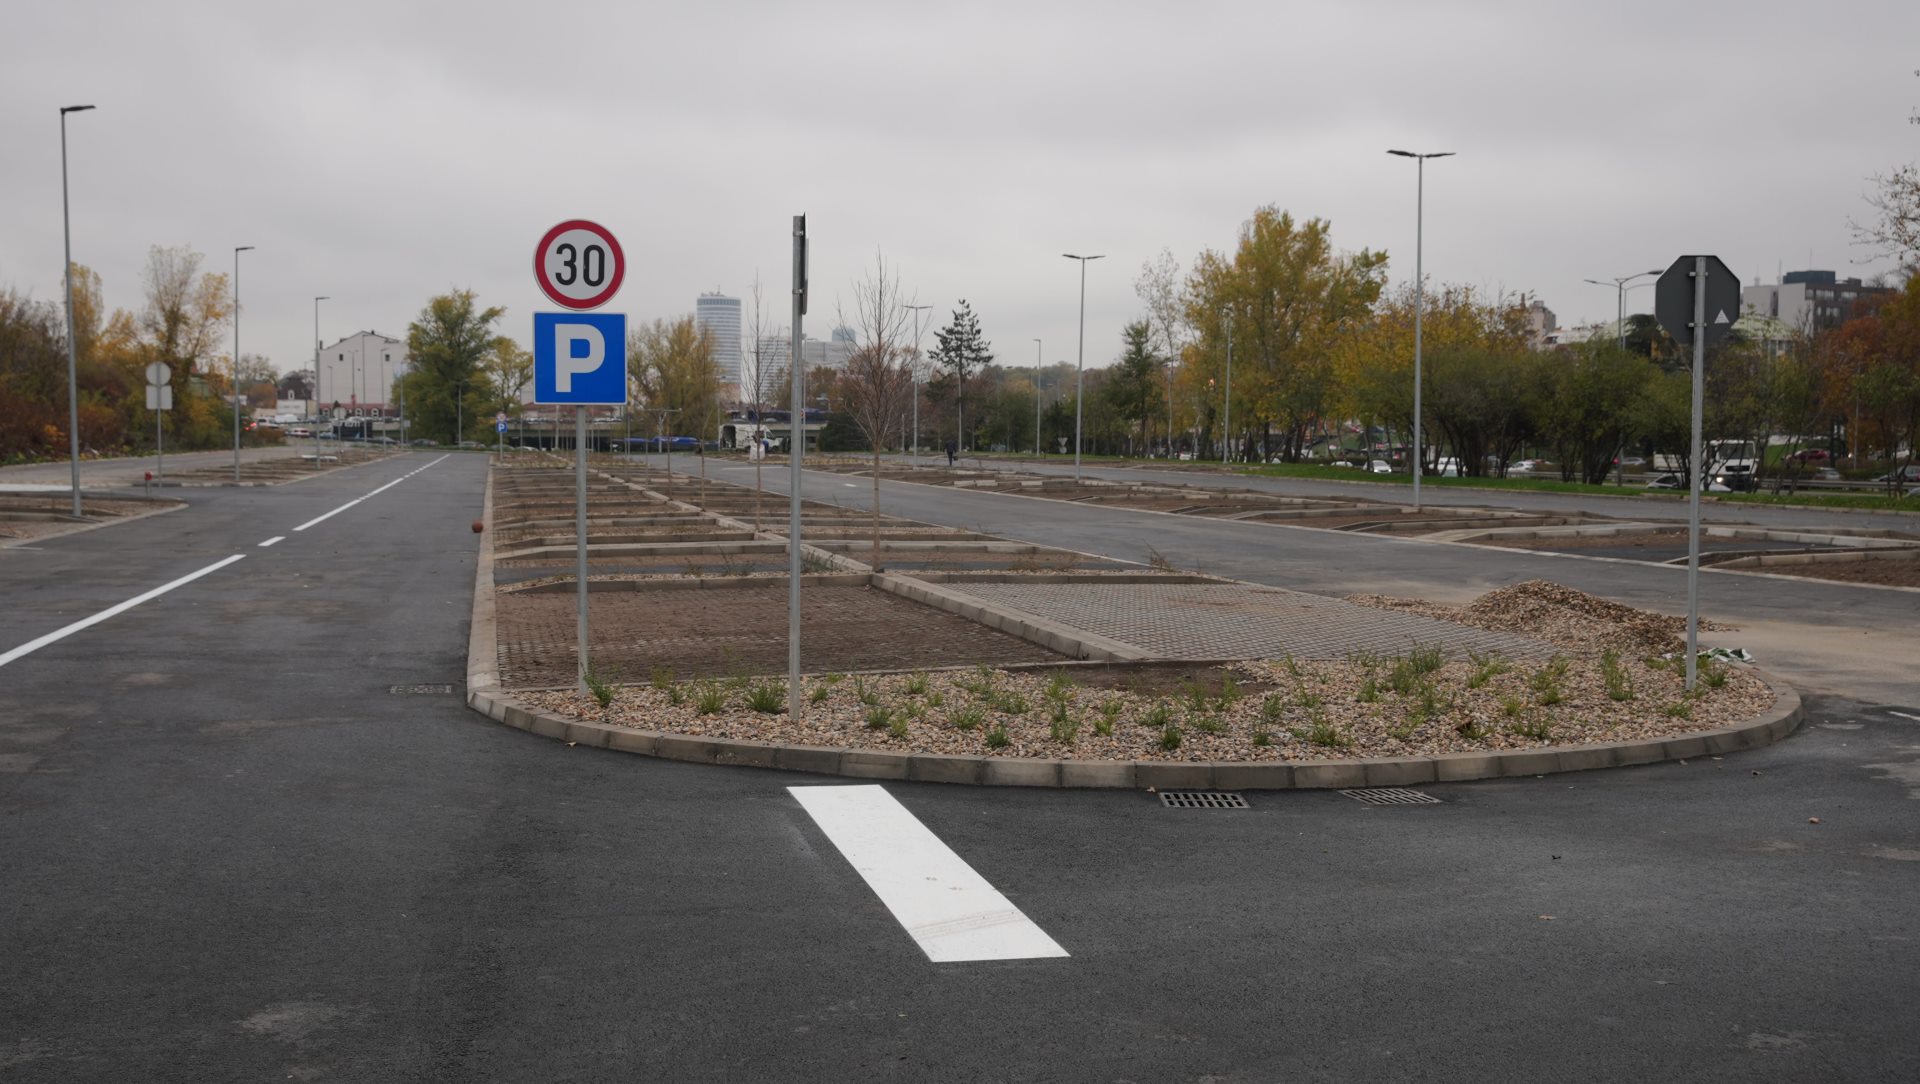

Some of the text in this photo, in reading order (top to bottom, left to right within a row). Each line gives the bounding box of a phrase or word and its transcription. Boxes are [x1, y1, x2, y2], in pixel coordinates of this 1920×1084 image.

[555, 243, 605, 287] 30
[555, 323, 605, 393] P
[498, 423, 505, 432] P
